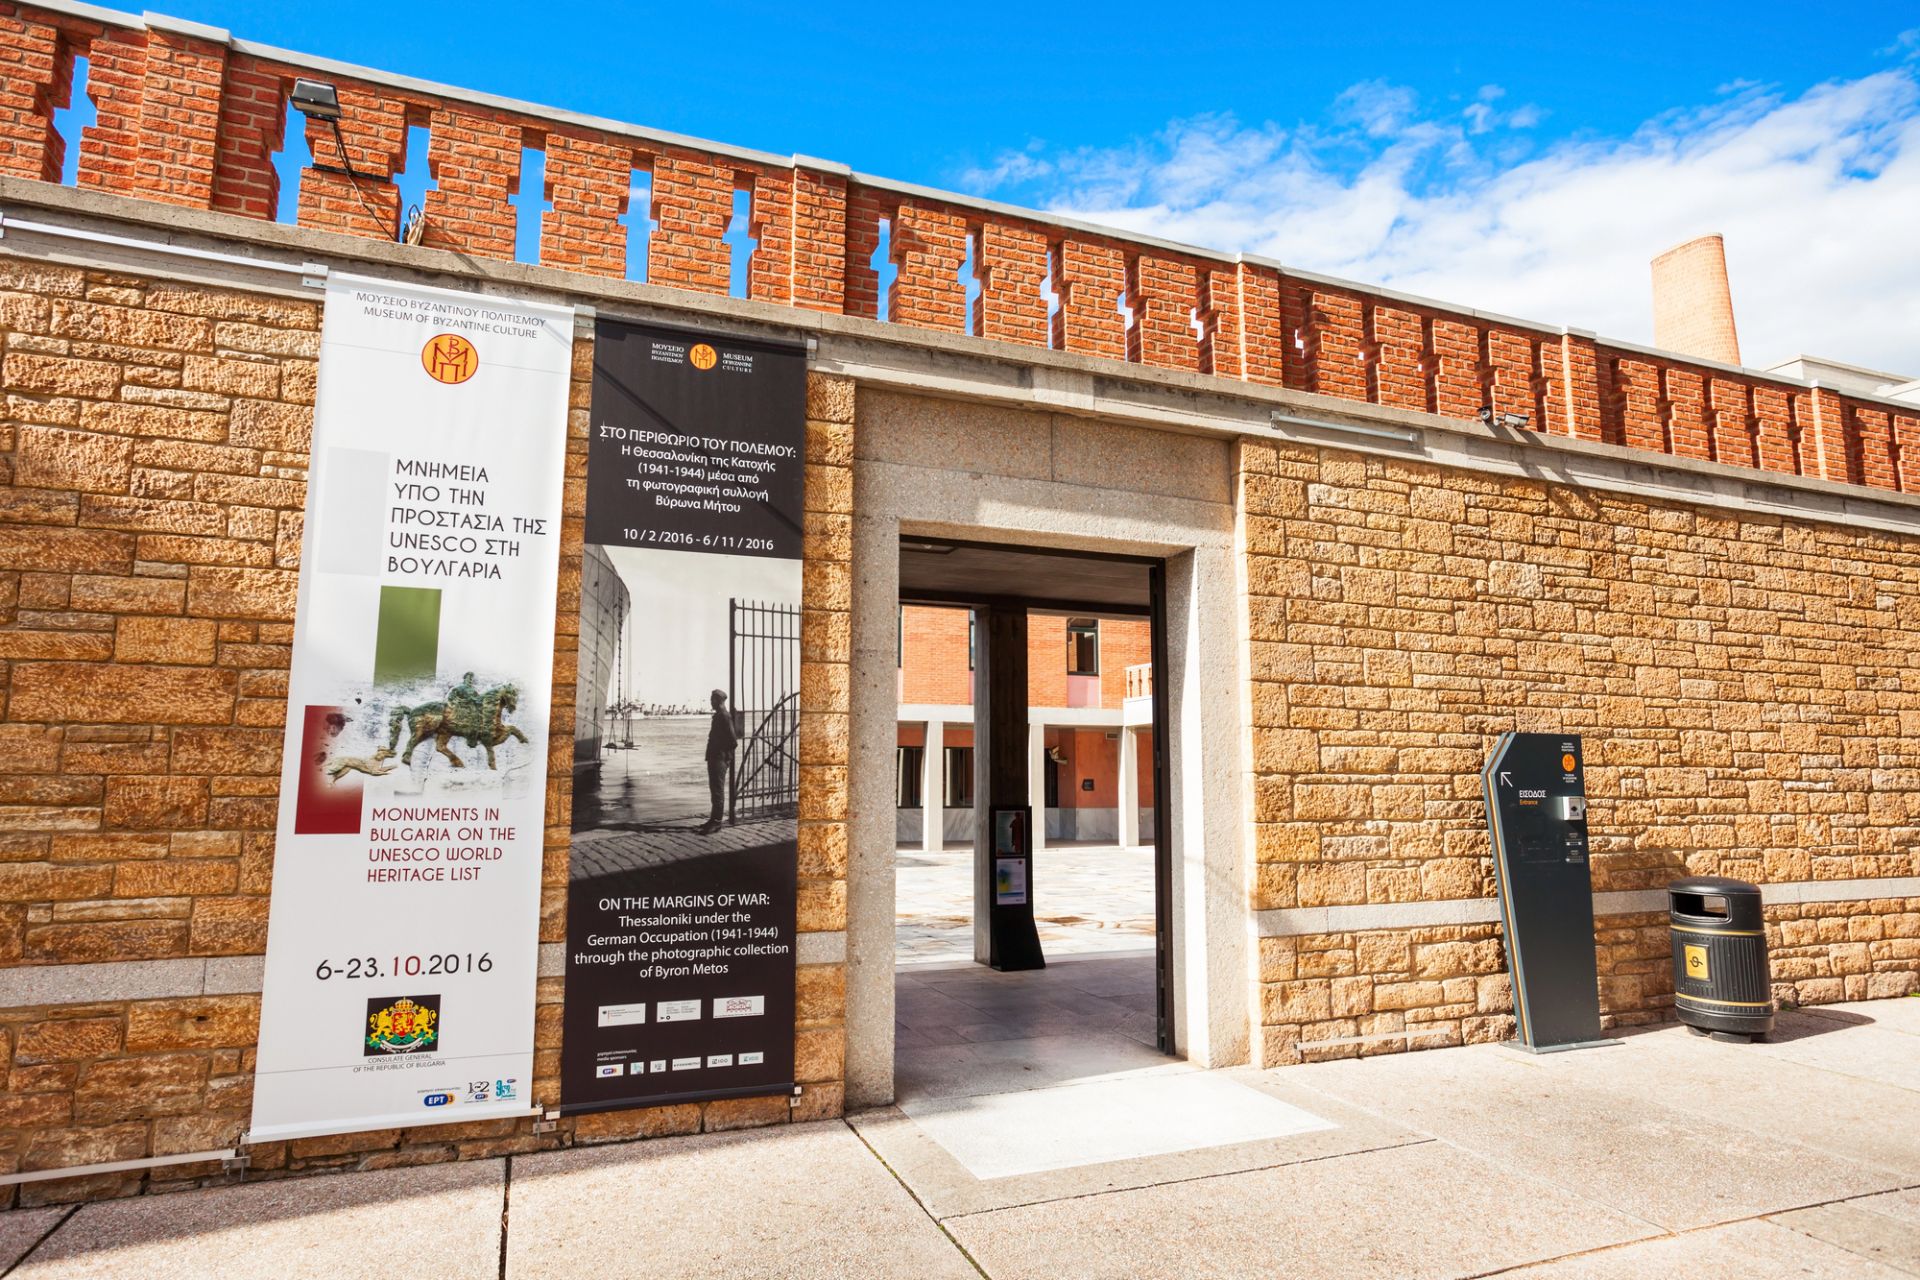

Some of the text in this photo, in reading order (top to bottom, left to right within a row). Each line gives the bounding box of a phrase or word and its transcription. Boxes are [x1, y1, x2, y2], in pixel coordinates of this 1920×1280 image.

[356, 292, 546, 328] ΜΟΥΣΕΙΟ ΒΥΖΑΝΤΙΝΟΥ ΠΟΛΙΤΙΣΜΟΥ
[363, 306, 537, 339] MUSEUM OF BYZANTINE CULTURE
[723, 353, 753, 362] MUSEUM
[722, 365, 752, 373] CULTURE
[600, 426, 797, 458] ΣΤΟ ΠΕΡΙΘΩΡΙΟ ΤΟΥ ΠΟΛΕΜΟΥ:
[621, 445, 776, 472] Η Θεσσαλονίκη της Κατοχής
[396, 458, 489, 483] ΜΝΗΜΕΙΑ
[638, 463, 759, 484] (1941-1944) μέσα από
[395, 483, 485, 506] ΥΠΟ ΤΗΝ
[626, 478, 769, 502] τη φωτογραφική συλλογή
[655, 494, 741, 513] Βύρωνα Μήτου
[391, 507, 547, 535] ΠΡΟΣΤΑΣΙΑ ΤΗΣ
[390, 531, 520, 557] UNESCO ΣΤΗ
[388, 556, 501, 579] ΒΟΥΛΓΑΡΙΑ
[372, 808, 499, 822] MONUMENTS IN
[370, 827, 516, 842] BULGARIA ON THE
[369, 847, 502, 862] UNESCO WORLD
[367, 867, 481, 882] HERITAGE LIST
[599, 893, 770, 911] ON THE MARGINS OF WAR:
[619, 912, 751, 927] Thessaloniki under the
[587, 926, 778, 946] German Occupation (1941-1944)
[575, 943, 789, 965] through the photographic collection
[639, 963, 729, 980] of Byron Metos
[376, 1063, 404, 1071] REPUBLIC
